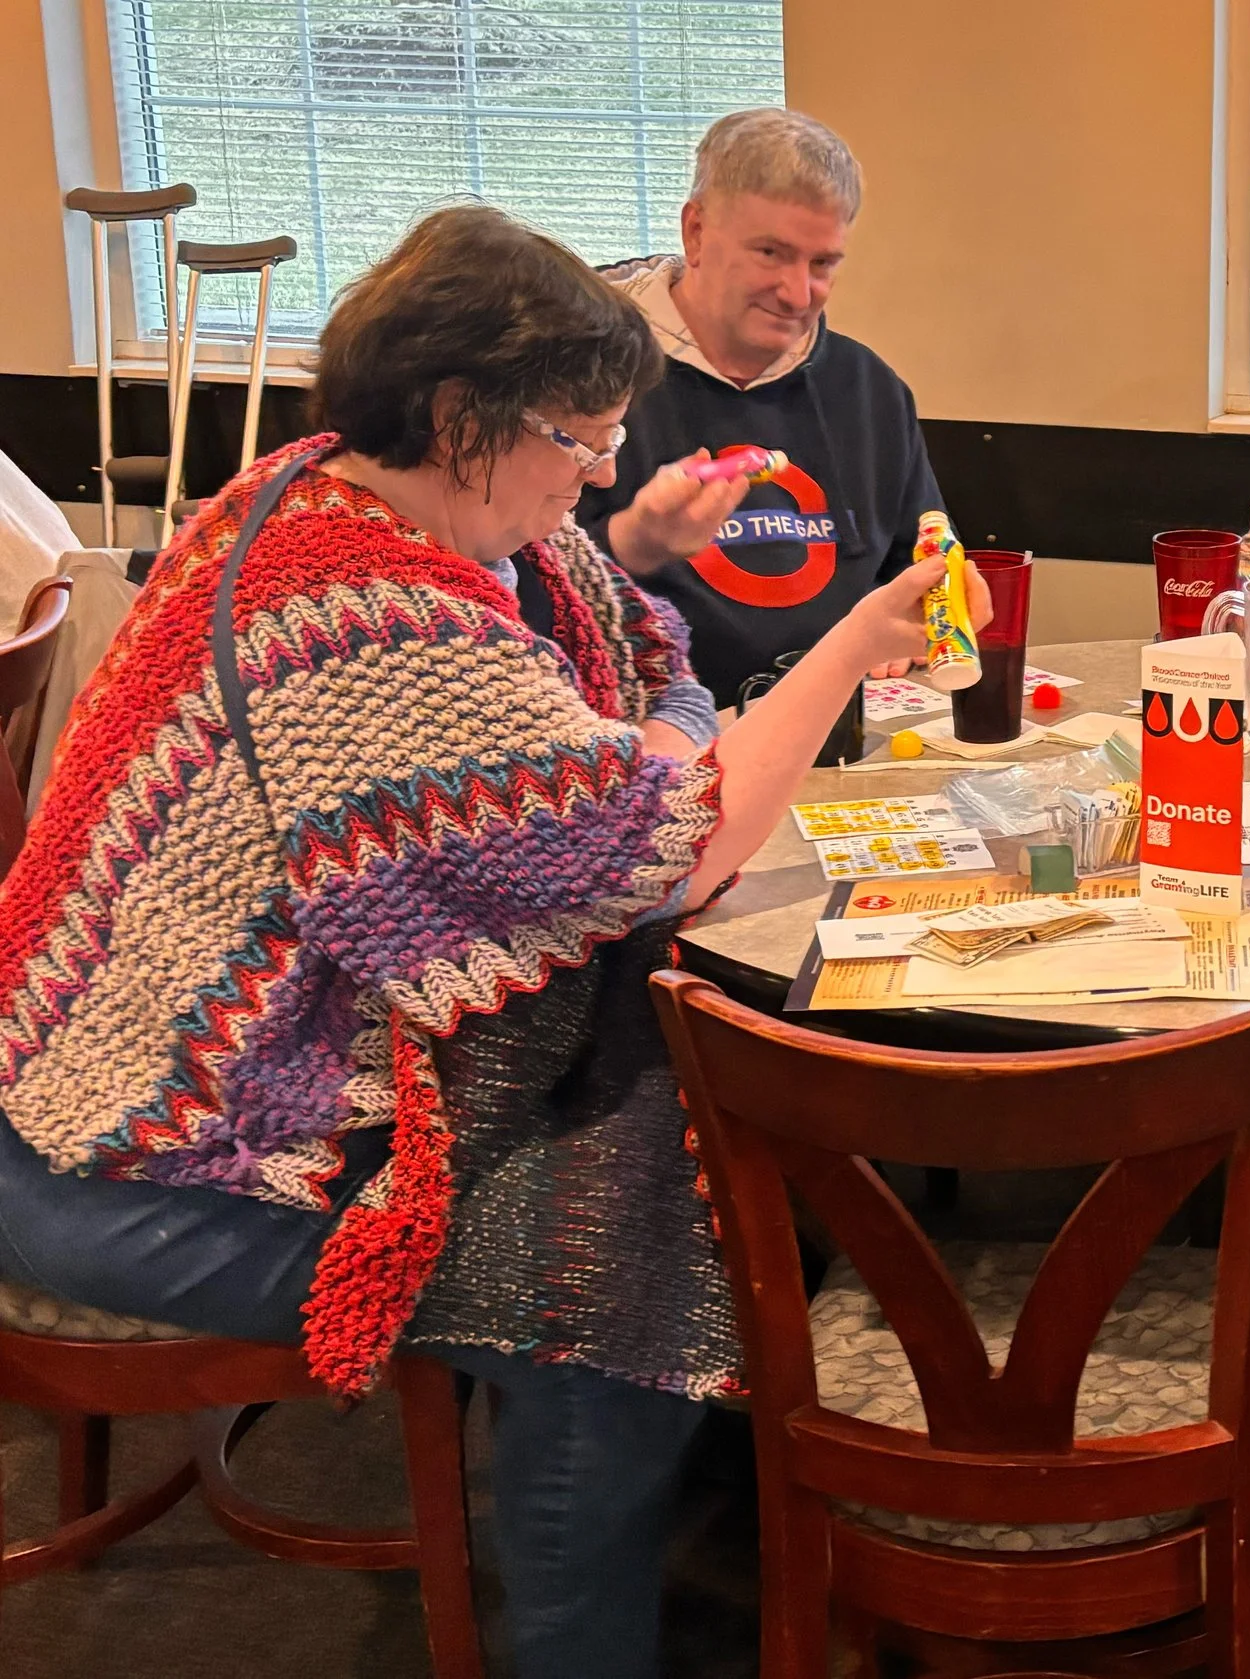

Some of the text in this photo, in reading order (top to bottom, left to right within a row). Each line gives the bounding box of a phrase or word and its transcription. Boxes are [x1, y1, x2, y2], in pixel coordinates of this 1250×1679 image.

[714, 516, 835, 540] ND THE GAP
[1147, 795, 1232, 825] Donate
[1157, 873, 1179, 883] Team
